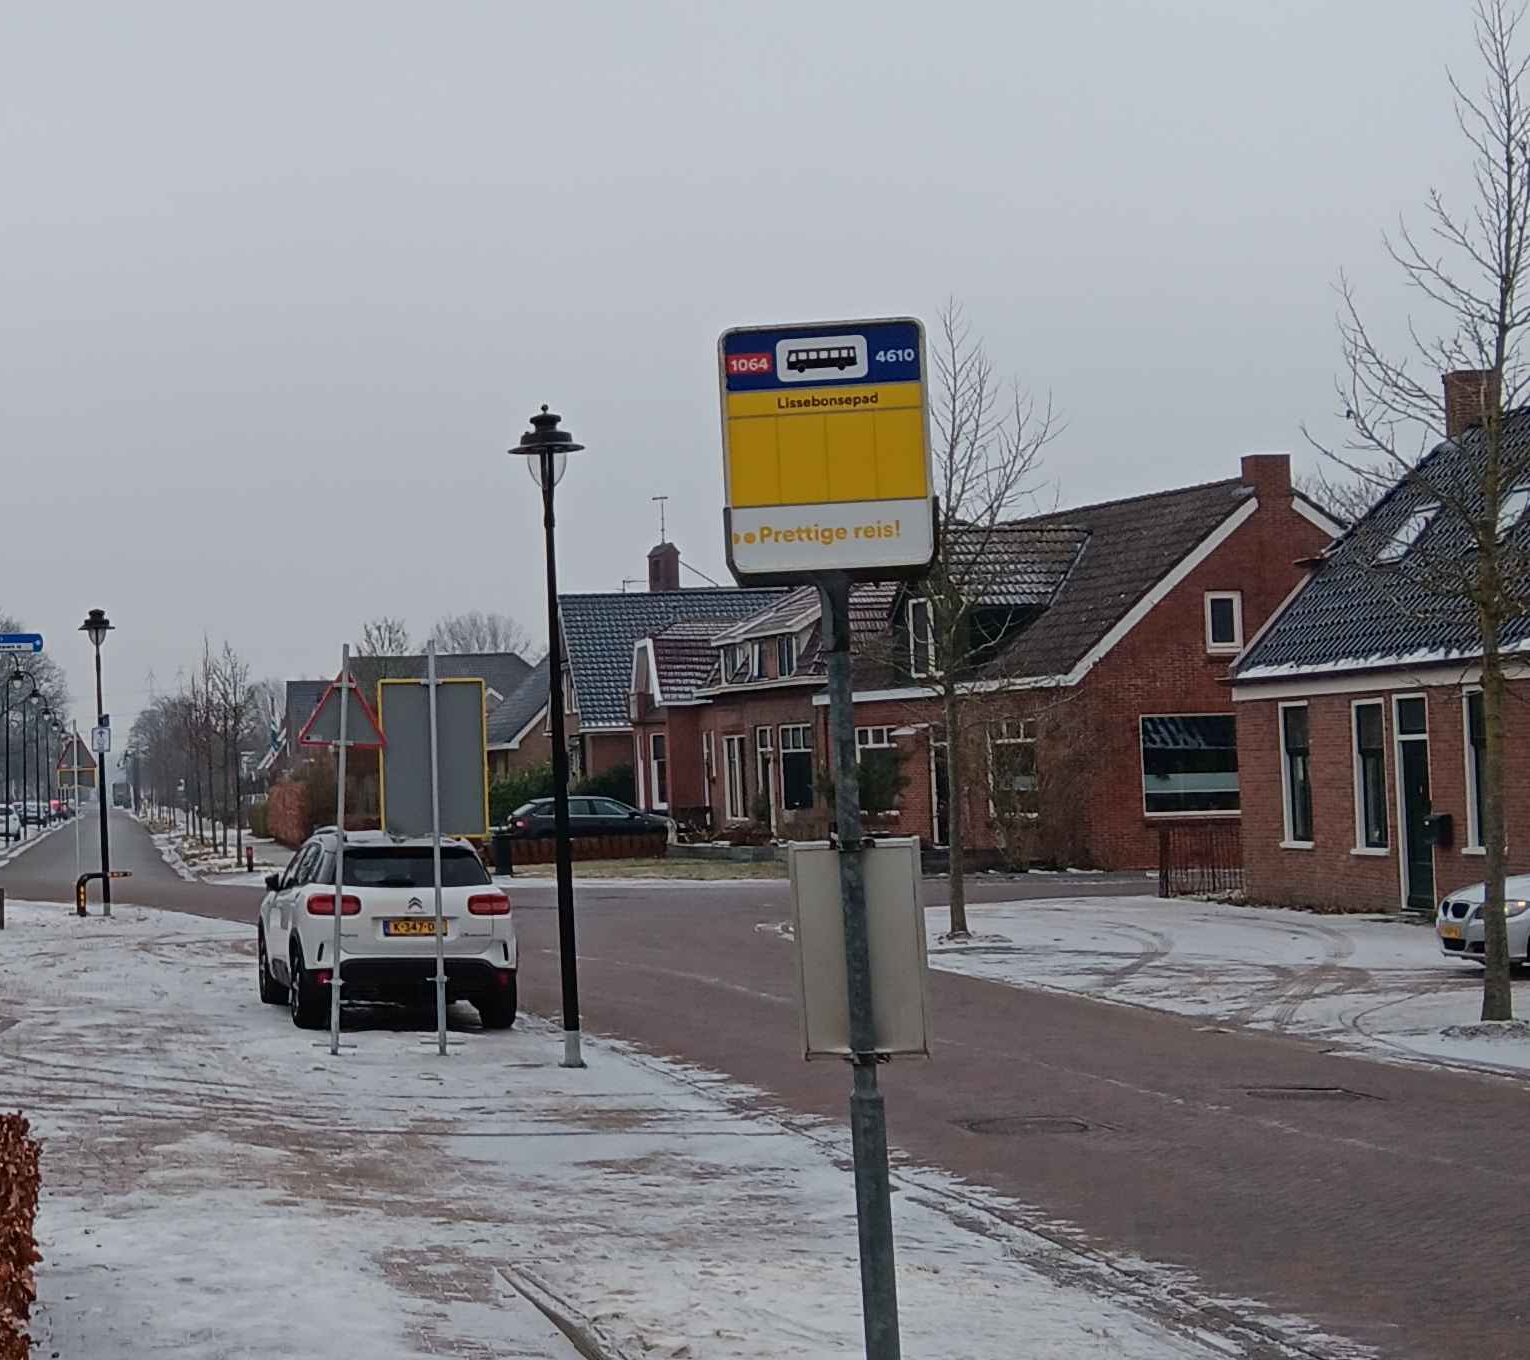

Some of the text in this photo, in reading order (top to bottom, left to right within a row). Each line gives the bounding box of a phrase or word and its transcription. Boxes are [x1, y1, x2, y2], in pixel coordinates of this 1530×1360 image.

[874, 348, 916, 363] 4610
[730, 357, 769, 372] 1064
[777, 392, 879, 410] Lissebonsepad
[759, 519, 902, 546] Prettige reis!
